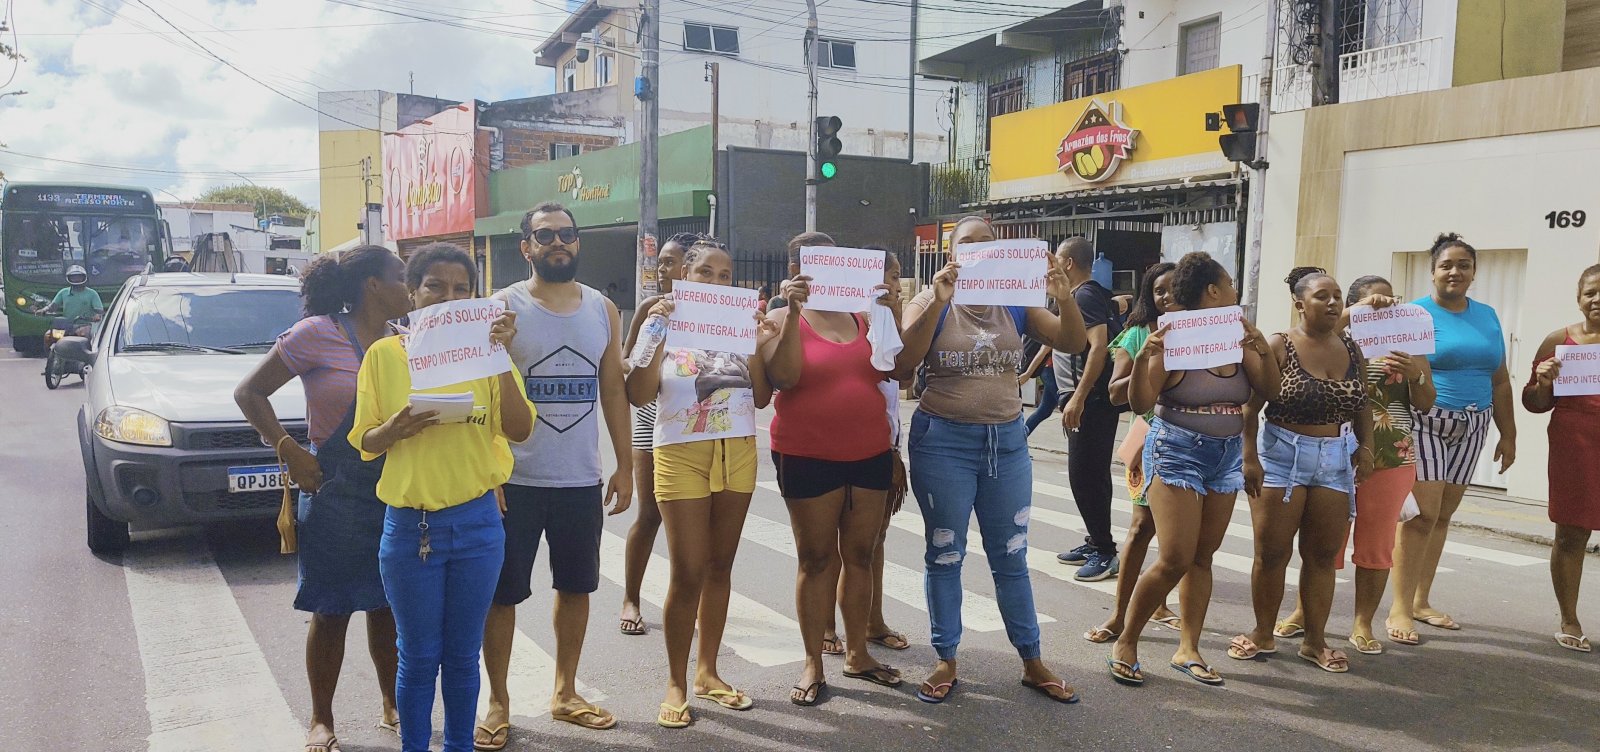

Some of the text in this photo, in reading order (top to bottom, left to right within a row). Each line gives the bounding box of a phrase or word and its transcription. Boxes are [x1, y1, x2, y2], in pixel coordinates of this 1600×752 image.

[1064, 129, 1127, 152] Armazém dos Frios
[558, 173, 575, 192] TOP
[64, 198, 101, 206] ACESSO
[75, 193, 124, 201] TERMINAL
[1545, 209, 1586, 229] 169
[802, 254, 884, 271] QUEREMOS SOLUÇÃO
[959, 246, 1047, 262] QUEREMOS SOLUÇÃO
[809, 284, 826, 296] MPO
[828, 285, 866, 299] INTEGRAL
[957, 279, 984, 290] TEMPO
[986, 278, 1028, 290] INTEGRAL
[673, 288, 758, 310] QUEREMOS SOLUÇÃO
[455, 304, 502, 324] SOLUÇÃO
[1209, 310, 1242, 327] SOLUÇÃO
[1352, 310, 1394, 324] QUEREMOS
[668, 319, 696, 333] TEMPO
[697, 322, 738, 338] INTEGRAL
[1380, 332, 1418, 345] INTEGRAL
[1165, 346, 1192, 358] TEMPO
[1193, 341, 1228, 355] INTEGRAL
[1560, 351, 1597, 361] UEREMOS
[408, 353, 439, 372] TEMPO
[439, 346, 484, 366] INTEGRAL
[529, 382, 593, 396] HURLEY
